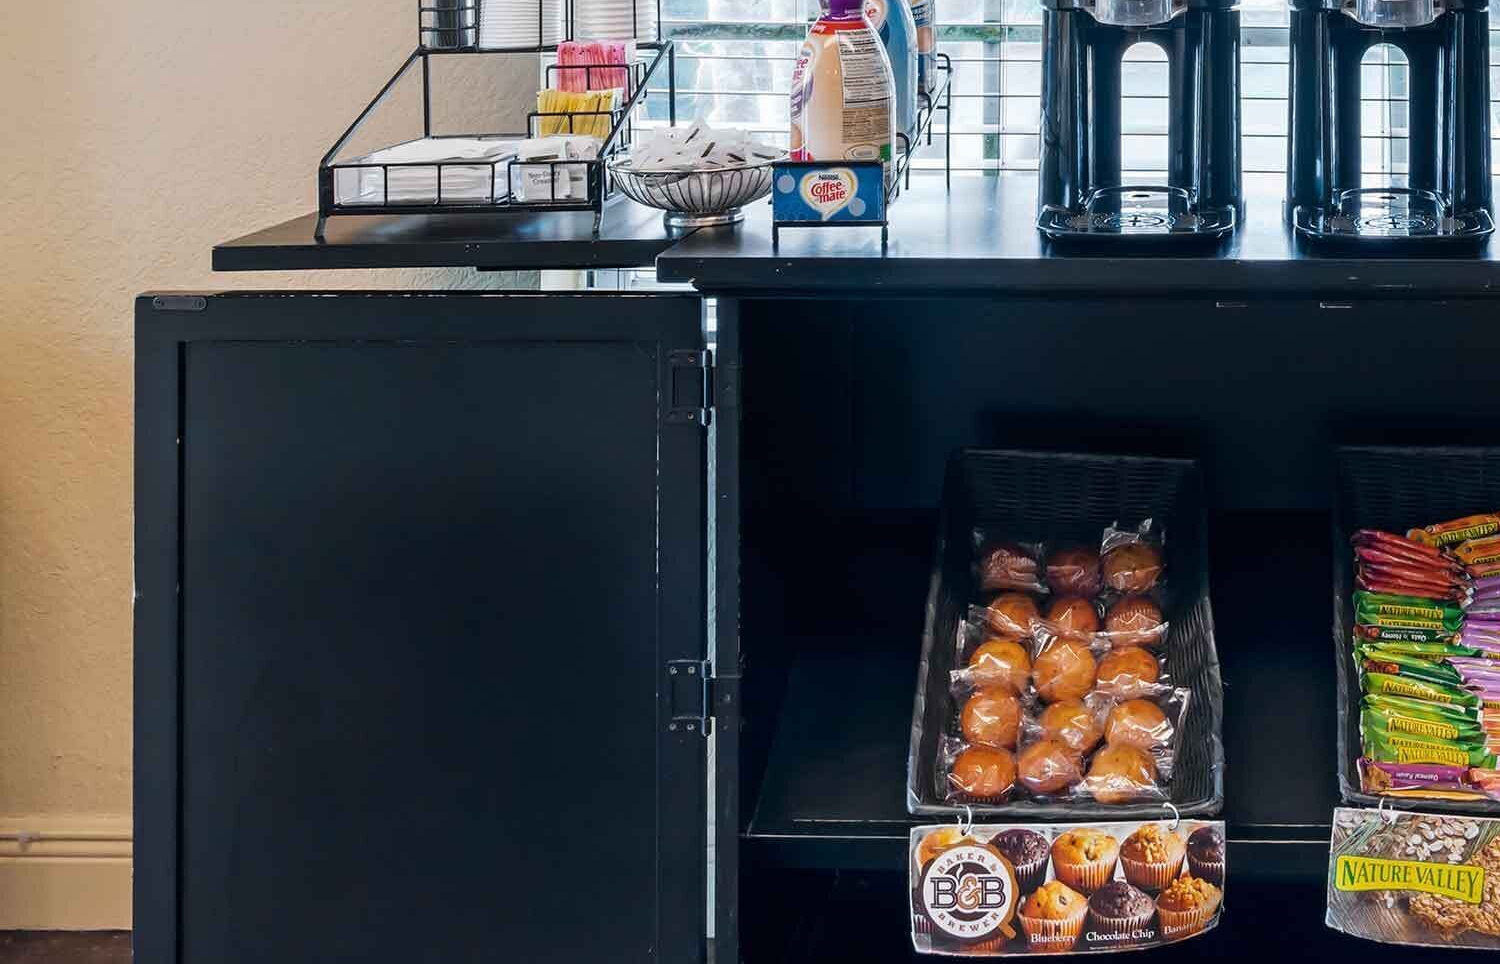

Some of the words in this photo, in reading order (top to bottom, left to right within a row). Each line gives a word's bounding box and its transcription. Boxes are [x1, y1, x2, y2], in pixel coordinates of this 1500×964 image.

[819, 189, 846, 204] mate
[938, 852, 985, 874] BAKER
[1342, 859, 1412, 886] NATURE
[1416, 865, 1479, 898] VALLEY
[930, 876, 1006, 910] B&B
[938, 912, 999, 932] BREWER
[1031, 933, 1076, 943] Blueberry
[1086, 931, 1131, 942] Chocolate
[1132, 929, 1154, 940] Chip
